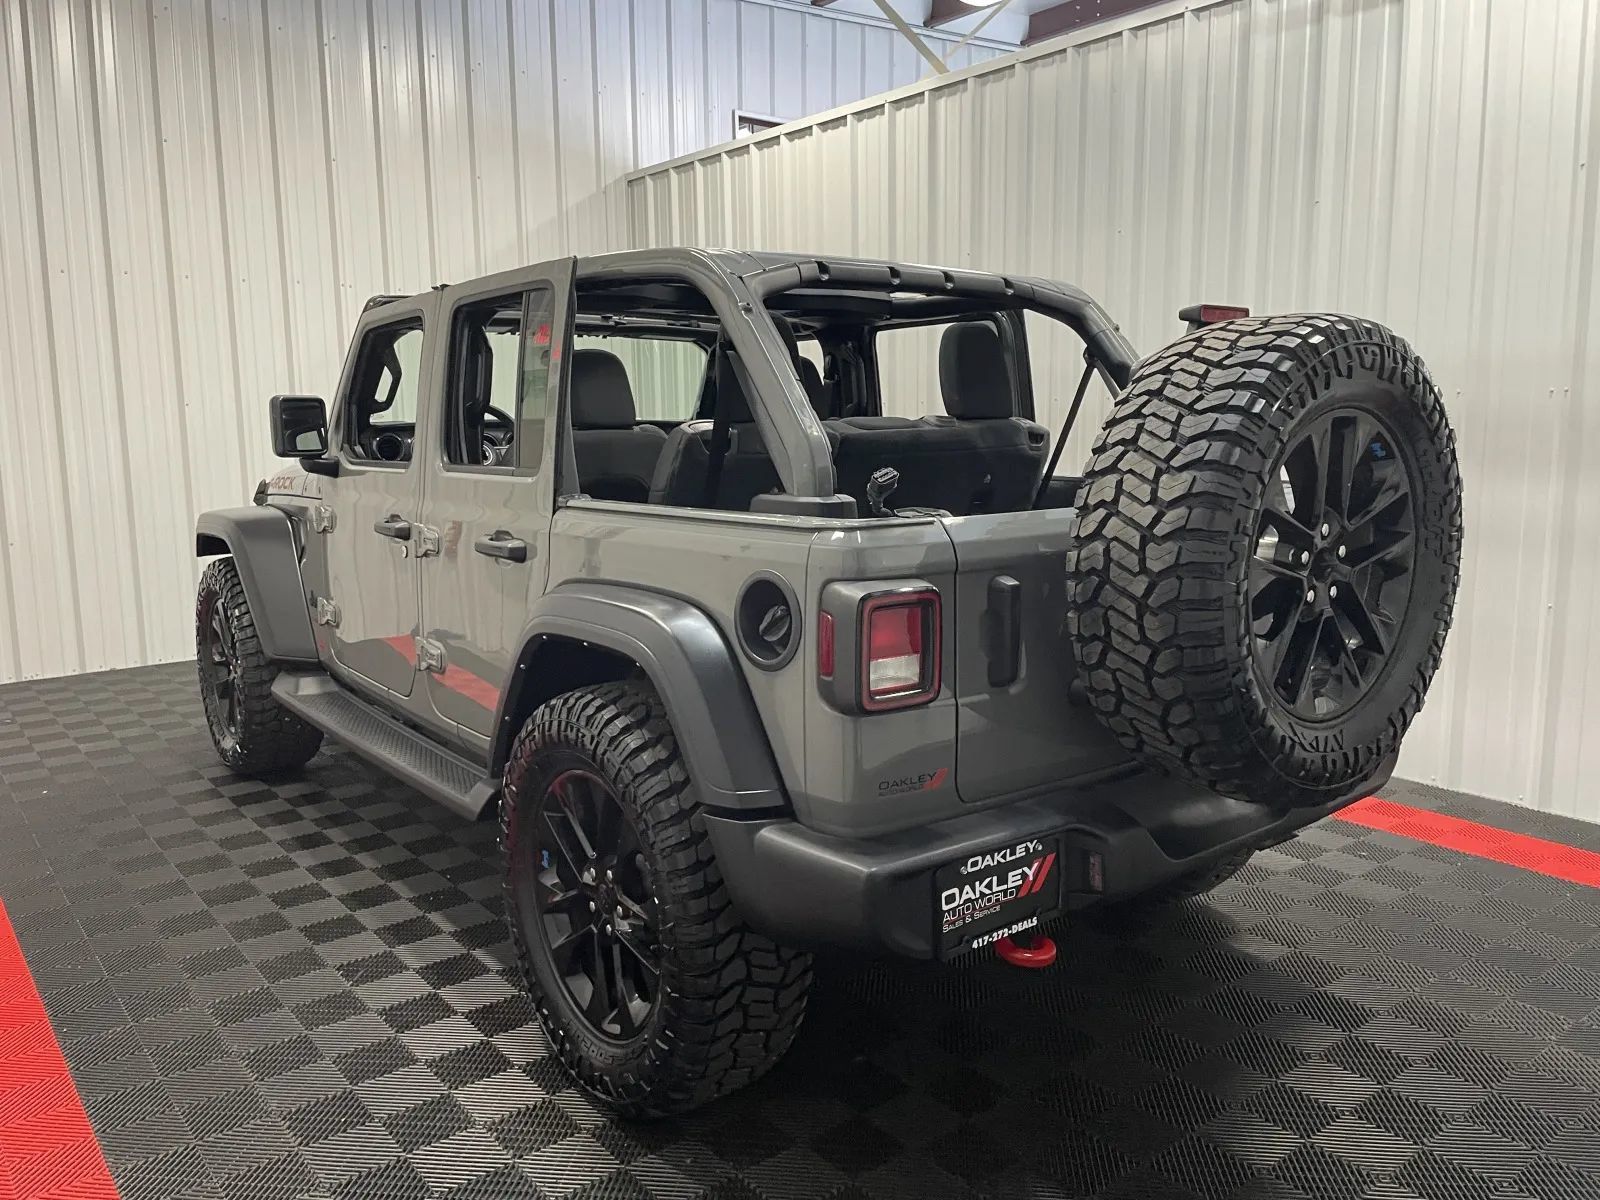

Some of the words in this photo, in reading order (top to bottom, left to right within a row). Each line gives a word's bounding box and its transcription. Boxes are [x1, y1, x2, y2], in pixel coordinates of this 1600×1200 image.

[878, 771, 937, 791] OAKLEY
[967, 839, 1038, 873] OAKLEY
[941, 861, 1040, 911] OAKLEY
[942, 902, 973, 924] AUTO
[974, 888, 1017, 910] WORLD
[965, 914, 972, 924] &
[971, 916, 1038, 949] 417-272-DEALS
